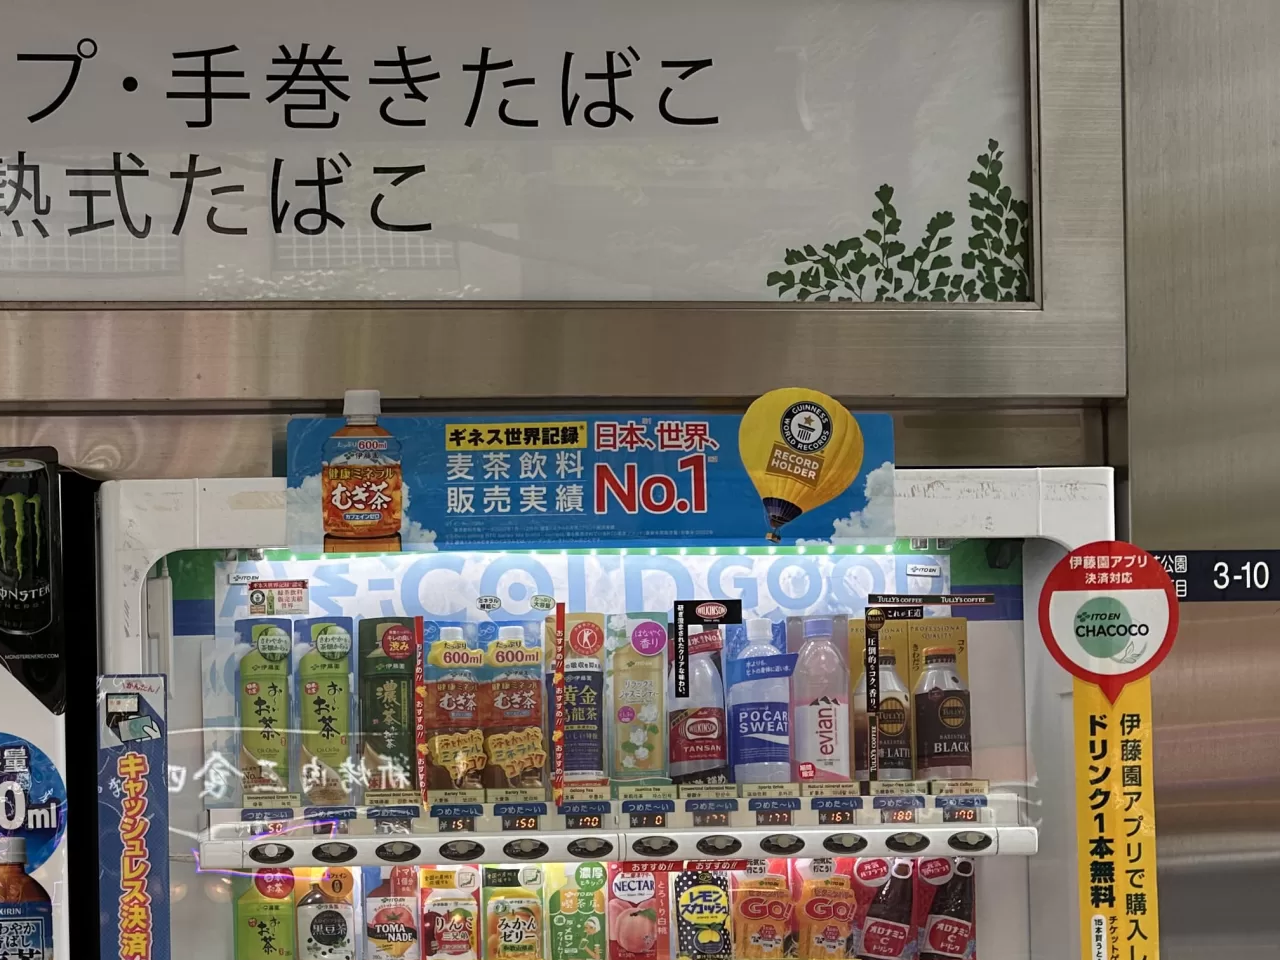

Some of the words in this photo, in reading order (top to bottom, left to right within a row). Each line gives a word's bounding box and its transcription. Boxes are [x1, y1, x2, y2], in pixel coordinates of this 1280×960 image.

[448, 426, 580, 447] ギネス世界記録
[446, 451, 585, 481] 麦茶飲料
[773, 449, 819, 470] RECORD
[328, 467, 394, 480] 健康ミネラル
[771, 458, 817, 480] HOLDER
[594, 455, 708, 516] No.1
[331, 481, 392, 511] むぎ茶
[446, 484, 585, 514] 販売実績
[1069, 555, 1148, 569] 伊藤園アプリ
[1085, 572, 1133, 584] 決済対応
[1212, 561, 1270, 590] 3-10
[695, 605, 727, 616] WILKINSON
[1075, 624, 1149, 638] CHACOCO
[639, 638, 659, 649] 香り
[493, 690, 537, 711] むぎ茶
[738, 722, 789, 733] SWEAT
[815, 701, 835, 756] evian
[683, 745, 722, 753] TANSAN
[933, 741, 970, 754] BLACK
[1088, 714, 1116, 909] ドリンク1本無料
[578, 867, 604, 879] 濃厚
[613, 879, 655, 892] NECTAR
[688, 891, 723, 903] レモン
[680, 902, 728, 915] スカッシュ
[740, 897, 795, 921] GO!
[313, 923, 348, 936] 黒豆茶
[375, 923, 406, 933] TOMA
[497, 917, 536, 930] みかん
[387, 931, 413, 942] NADE
[499, 931, 536, 943] ゼリー
[869, 924, 904, 939] オロナミン
